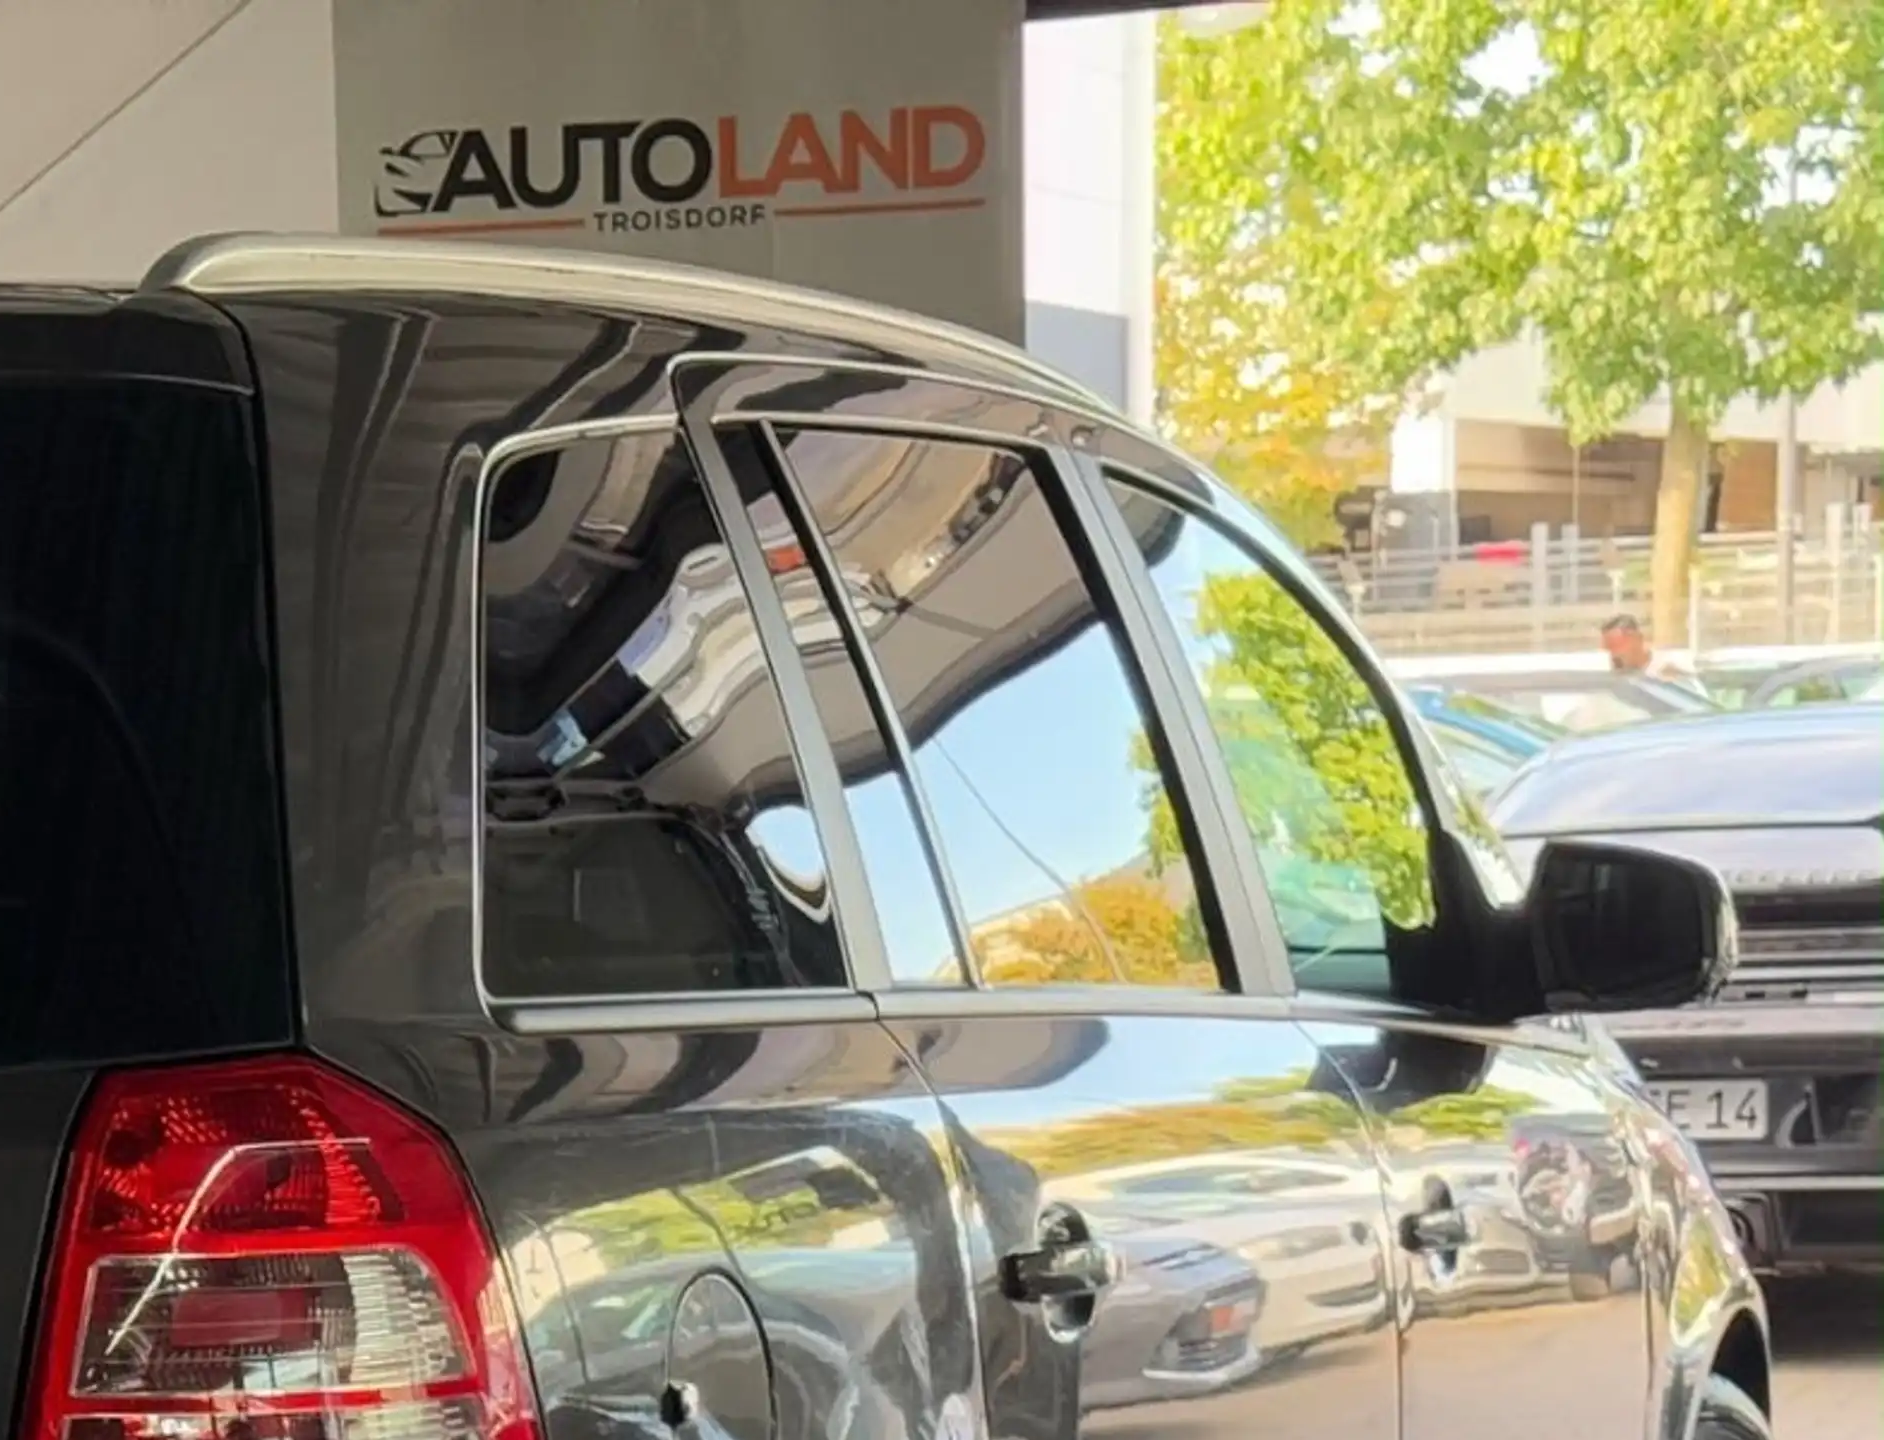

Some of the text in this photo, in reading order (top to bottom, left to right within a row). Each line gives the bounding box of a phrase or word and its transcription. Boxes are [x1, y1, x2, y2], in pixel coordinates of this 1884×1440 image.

[433, 105, 986, 212] AUTOLAND
[593, 206, 766, 233] TROISDORF
[1706, 1089, 1758, 1130] 14
